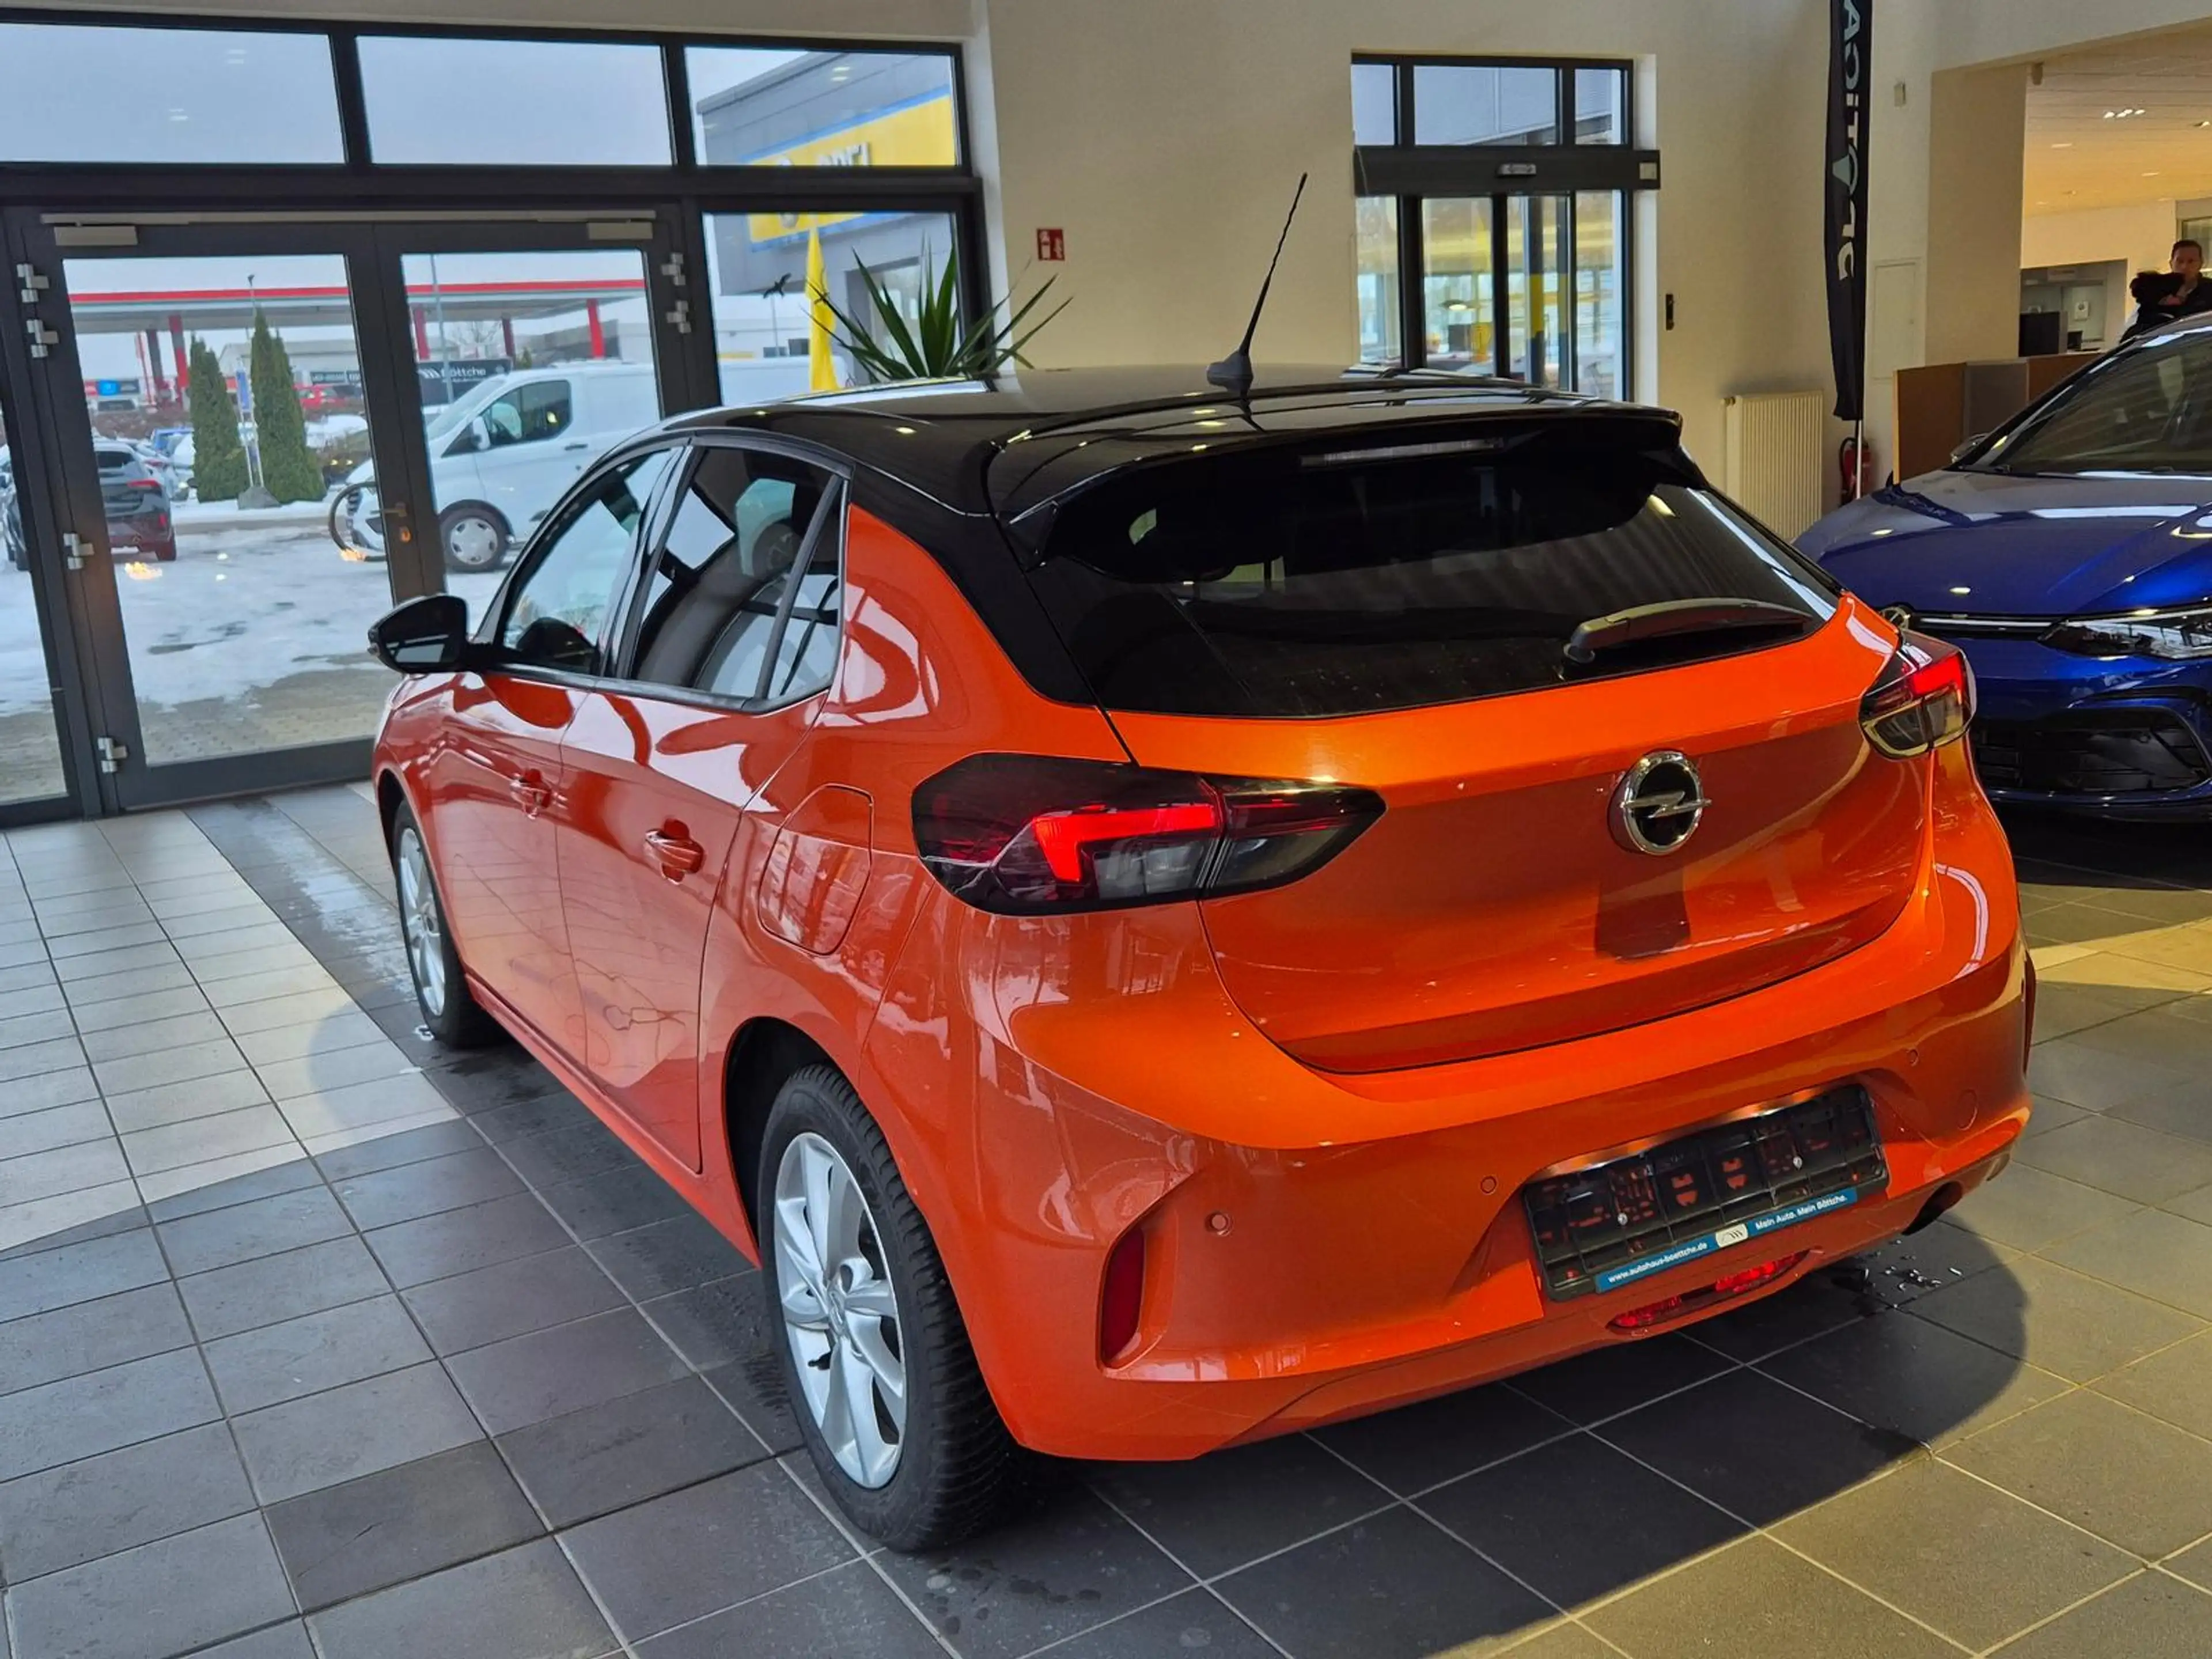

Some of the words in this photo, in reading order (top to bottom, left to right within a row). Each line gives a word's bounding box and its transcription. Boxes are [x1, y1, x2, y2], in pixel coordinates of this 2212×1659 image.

[1755, 1218, 1775, 1230] Mein
[1776, 1211, 1796, 1223] Auto.
[1797, 1204, 1816, 1215] Mein
[1608, 1242, 1707, 1283] www.autohaus-boettche.de
